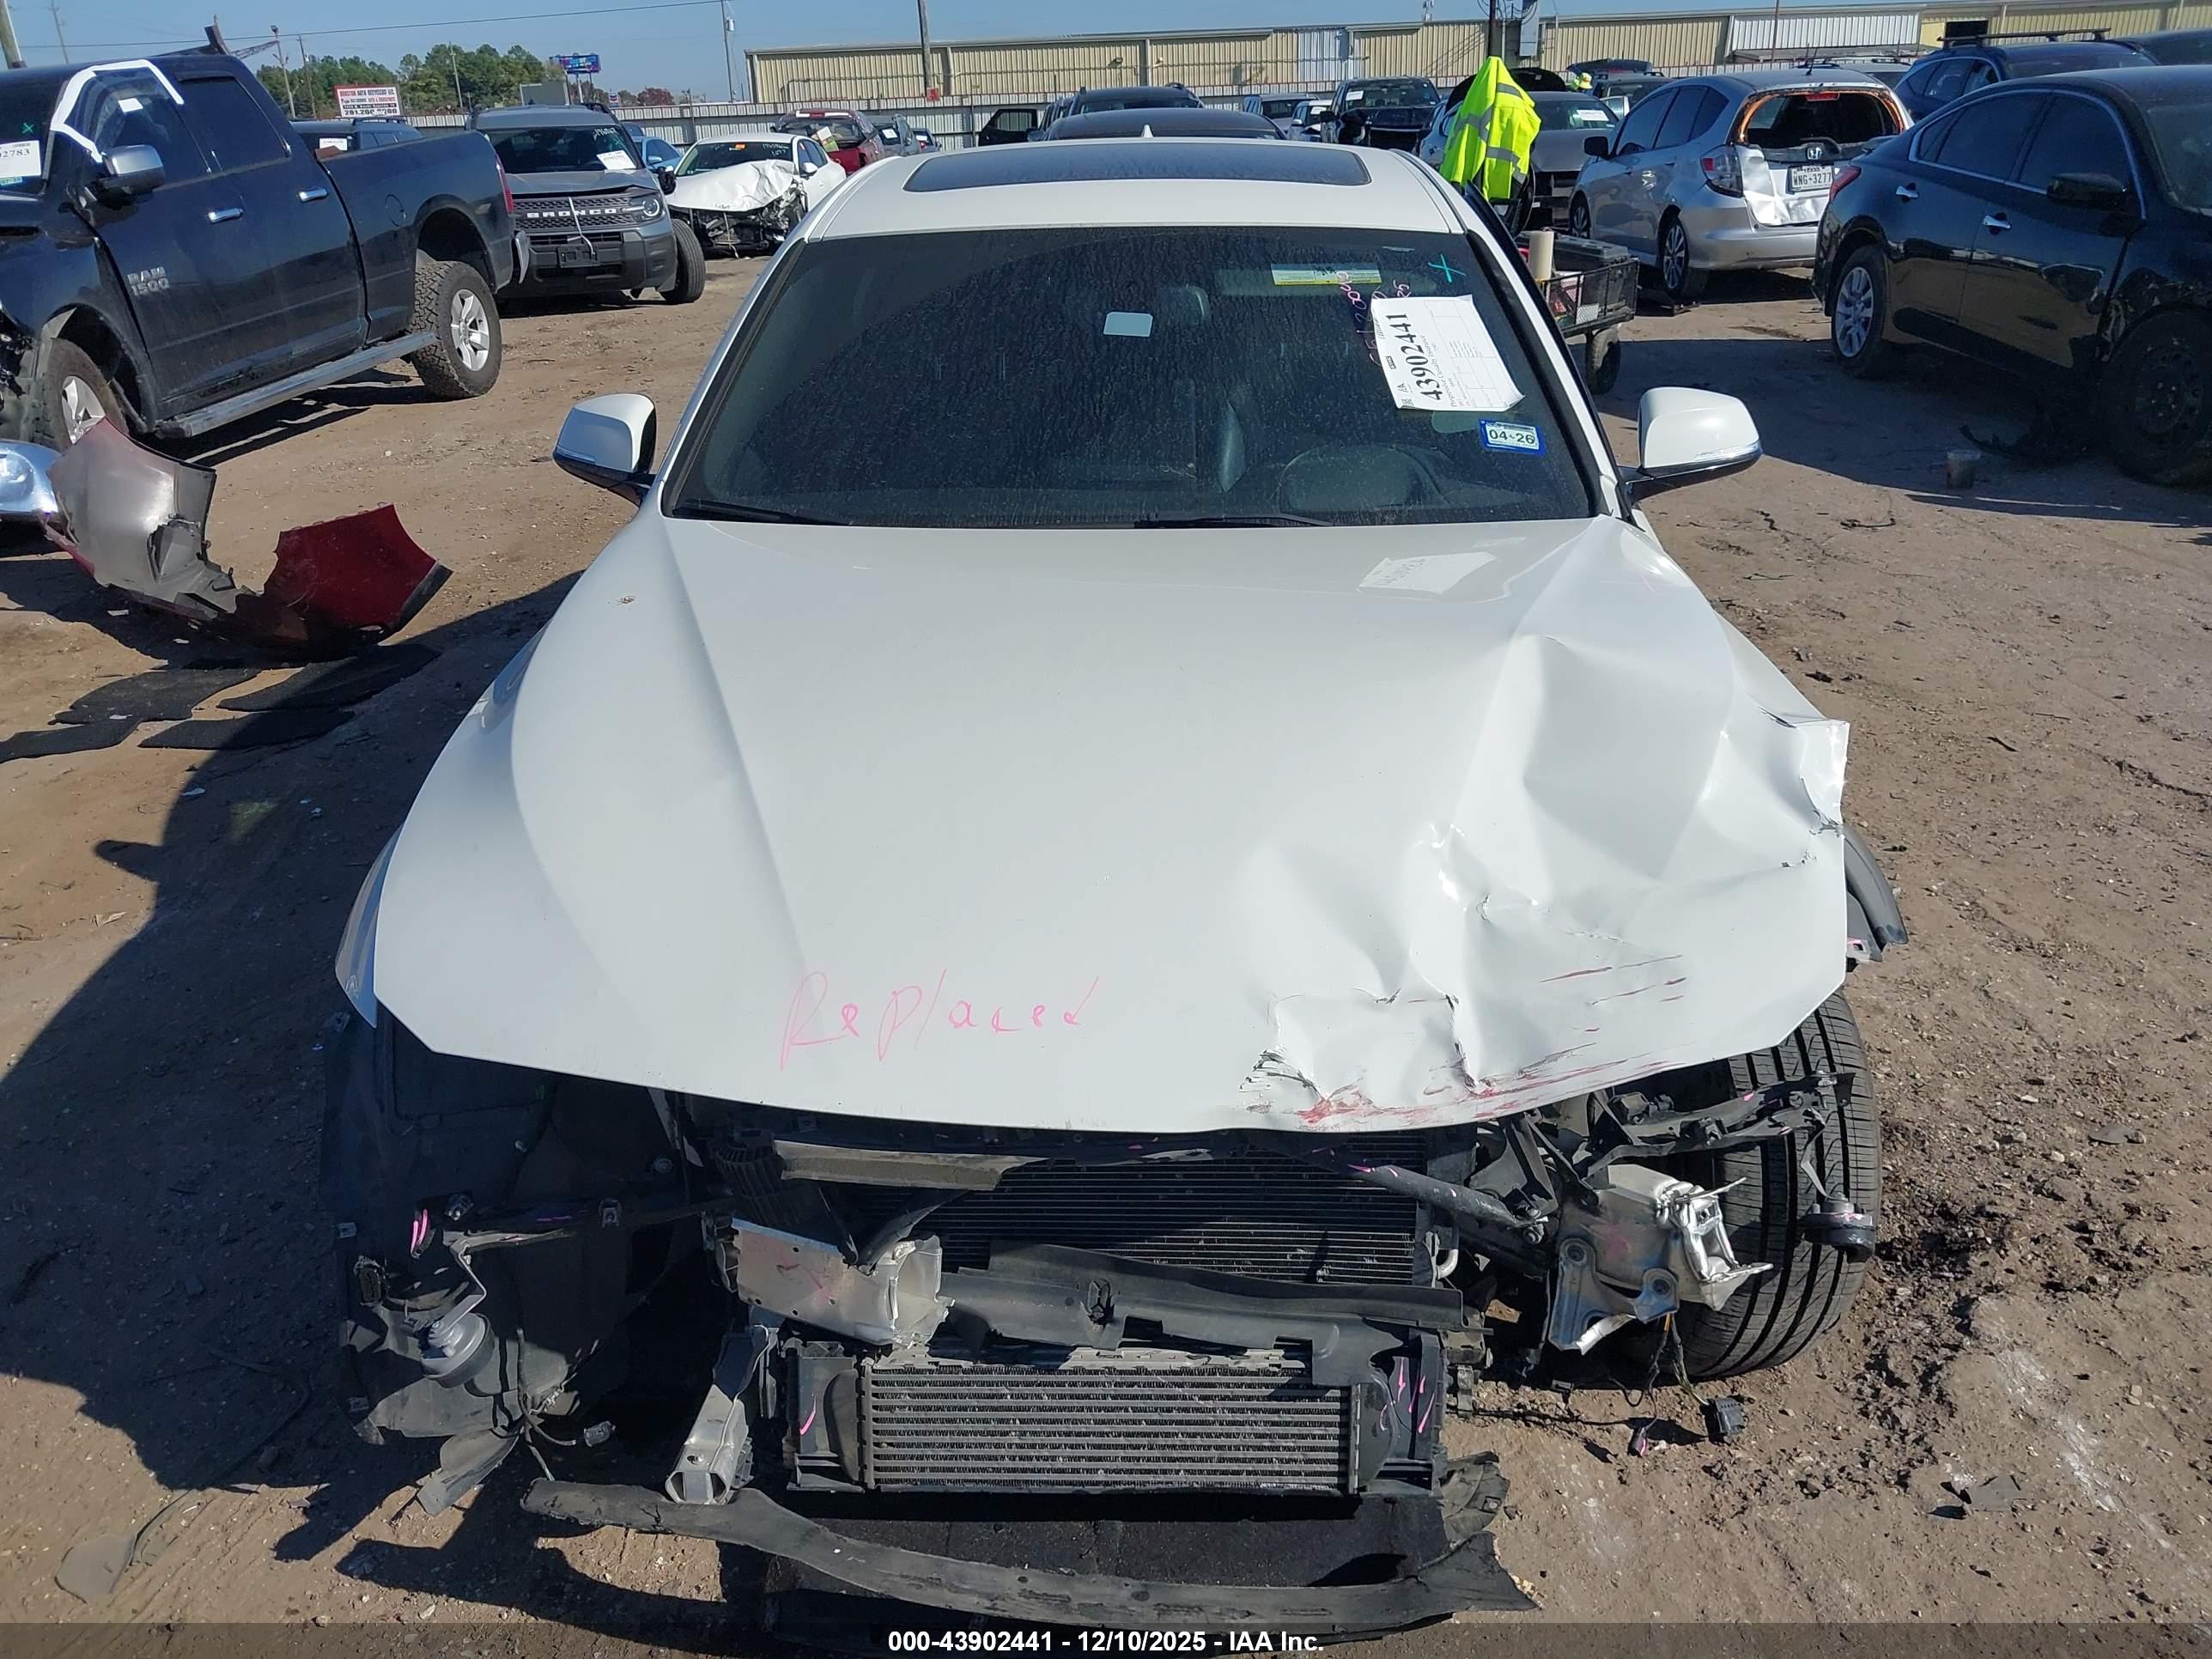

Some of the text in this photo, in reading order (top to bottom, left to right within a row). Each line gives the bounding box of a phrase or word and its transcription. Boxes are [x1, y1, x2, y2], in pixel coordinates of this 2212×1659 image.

[526, 208, 617, 218] BRONCO
[127, 266, 166, 285] RAM
[131, 277, 170, 296] 1500
[1384, 313, 1443, 401] 43902441
